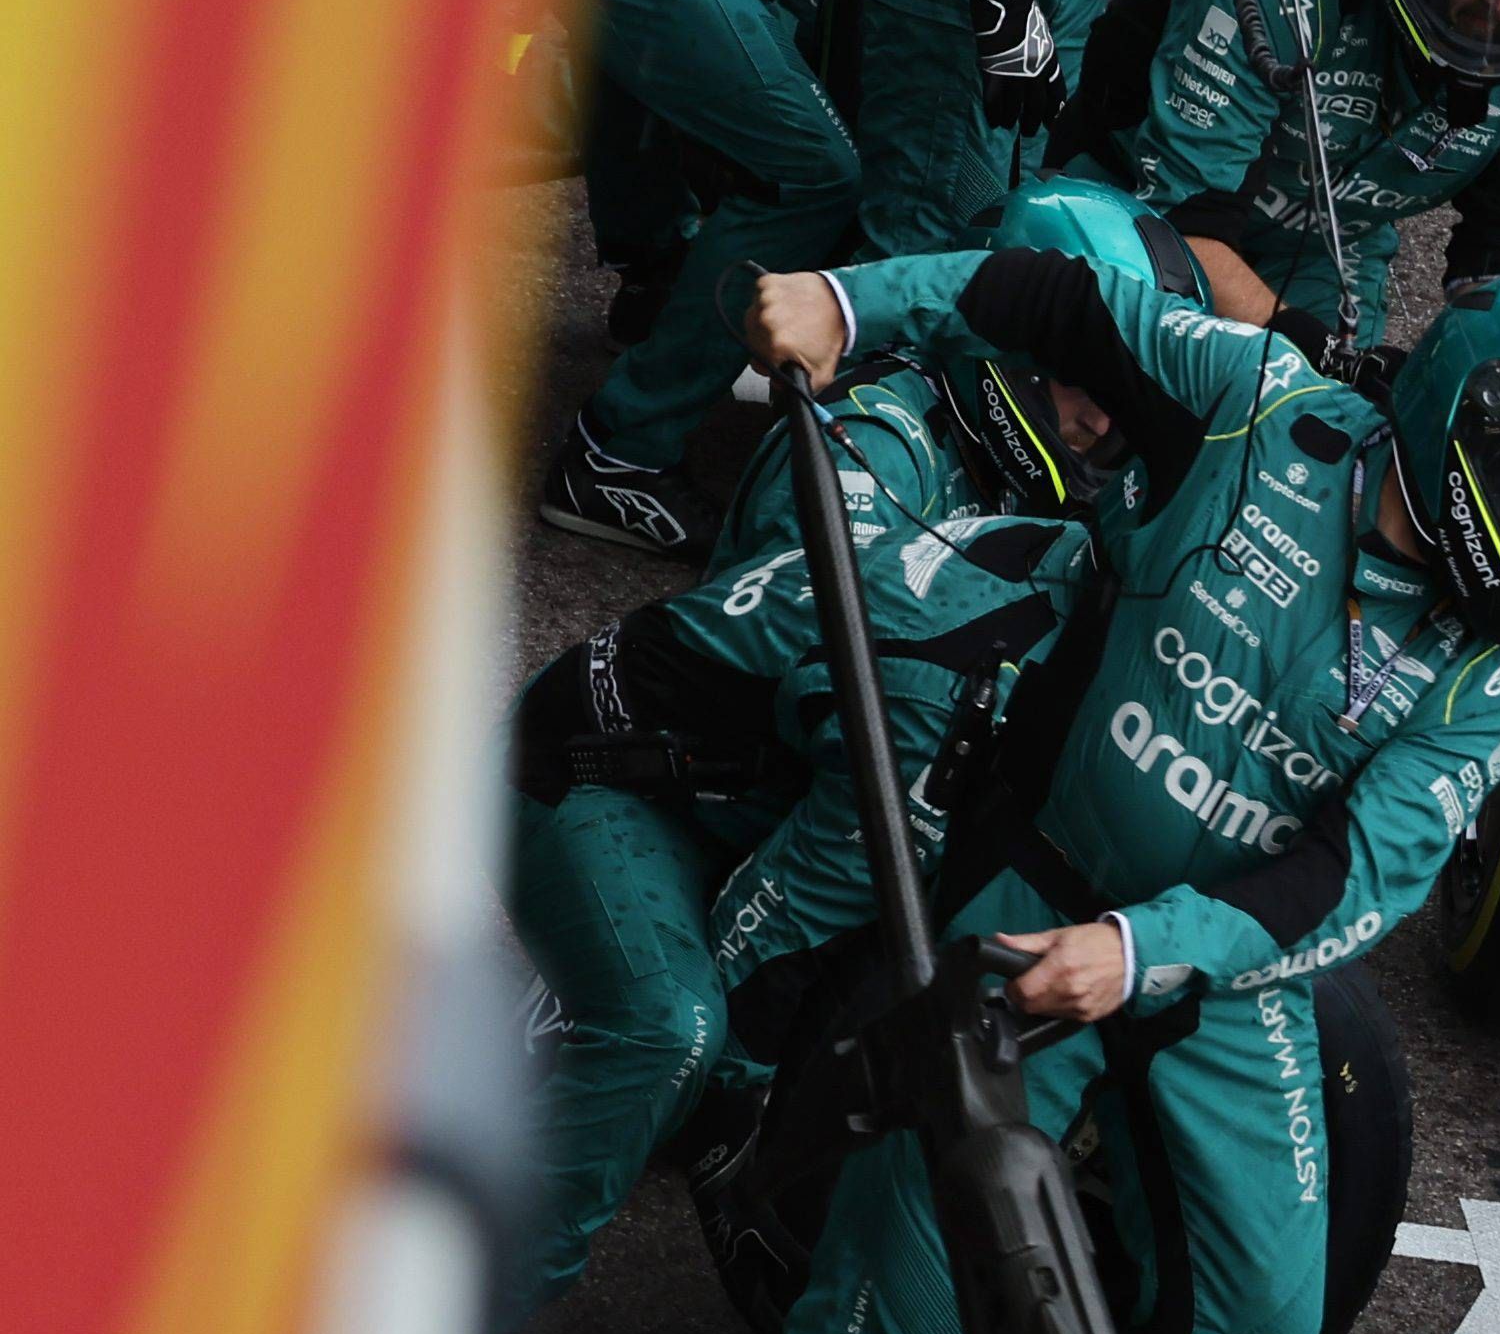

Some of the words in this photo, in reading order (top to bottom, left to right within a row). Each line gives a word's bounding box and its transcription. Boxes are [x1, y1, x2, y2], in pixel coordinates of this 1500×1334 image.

[982, 377, 1045, 481] cognizant
[1257, 469, 1322, 514] crypto.com
[1448, 469, 1500, 590] cognizant
[1241, 503, 1322, 577] aramco
[1362, 567, 1426, 598] cognizant
[1188, 579, 1261, 649] SentinelOne
[1154, 626, 1344, 790] cognizan
[1110, 700, 1304, 856] aramc
[1231, 910, 1383, 991] aramco
[669, 1004, 707, 1091] LAMBERT
[1257, 987, 1301, 1080] MART
[1283, 1086, 1319, 1204] ASTON
